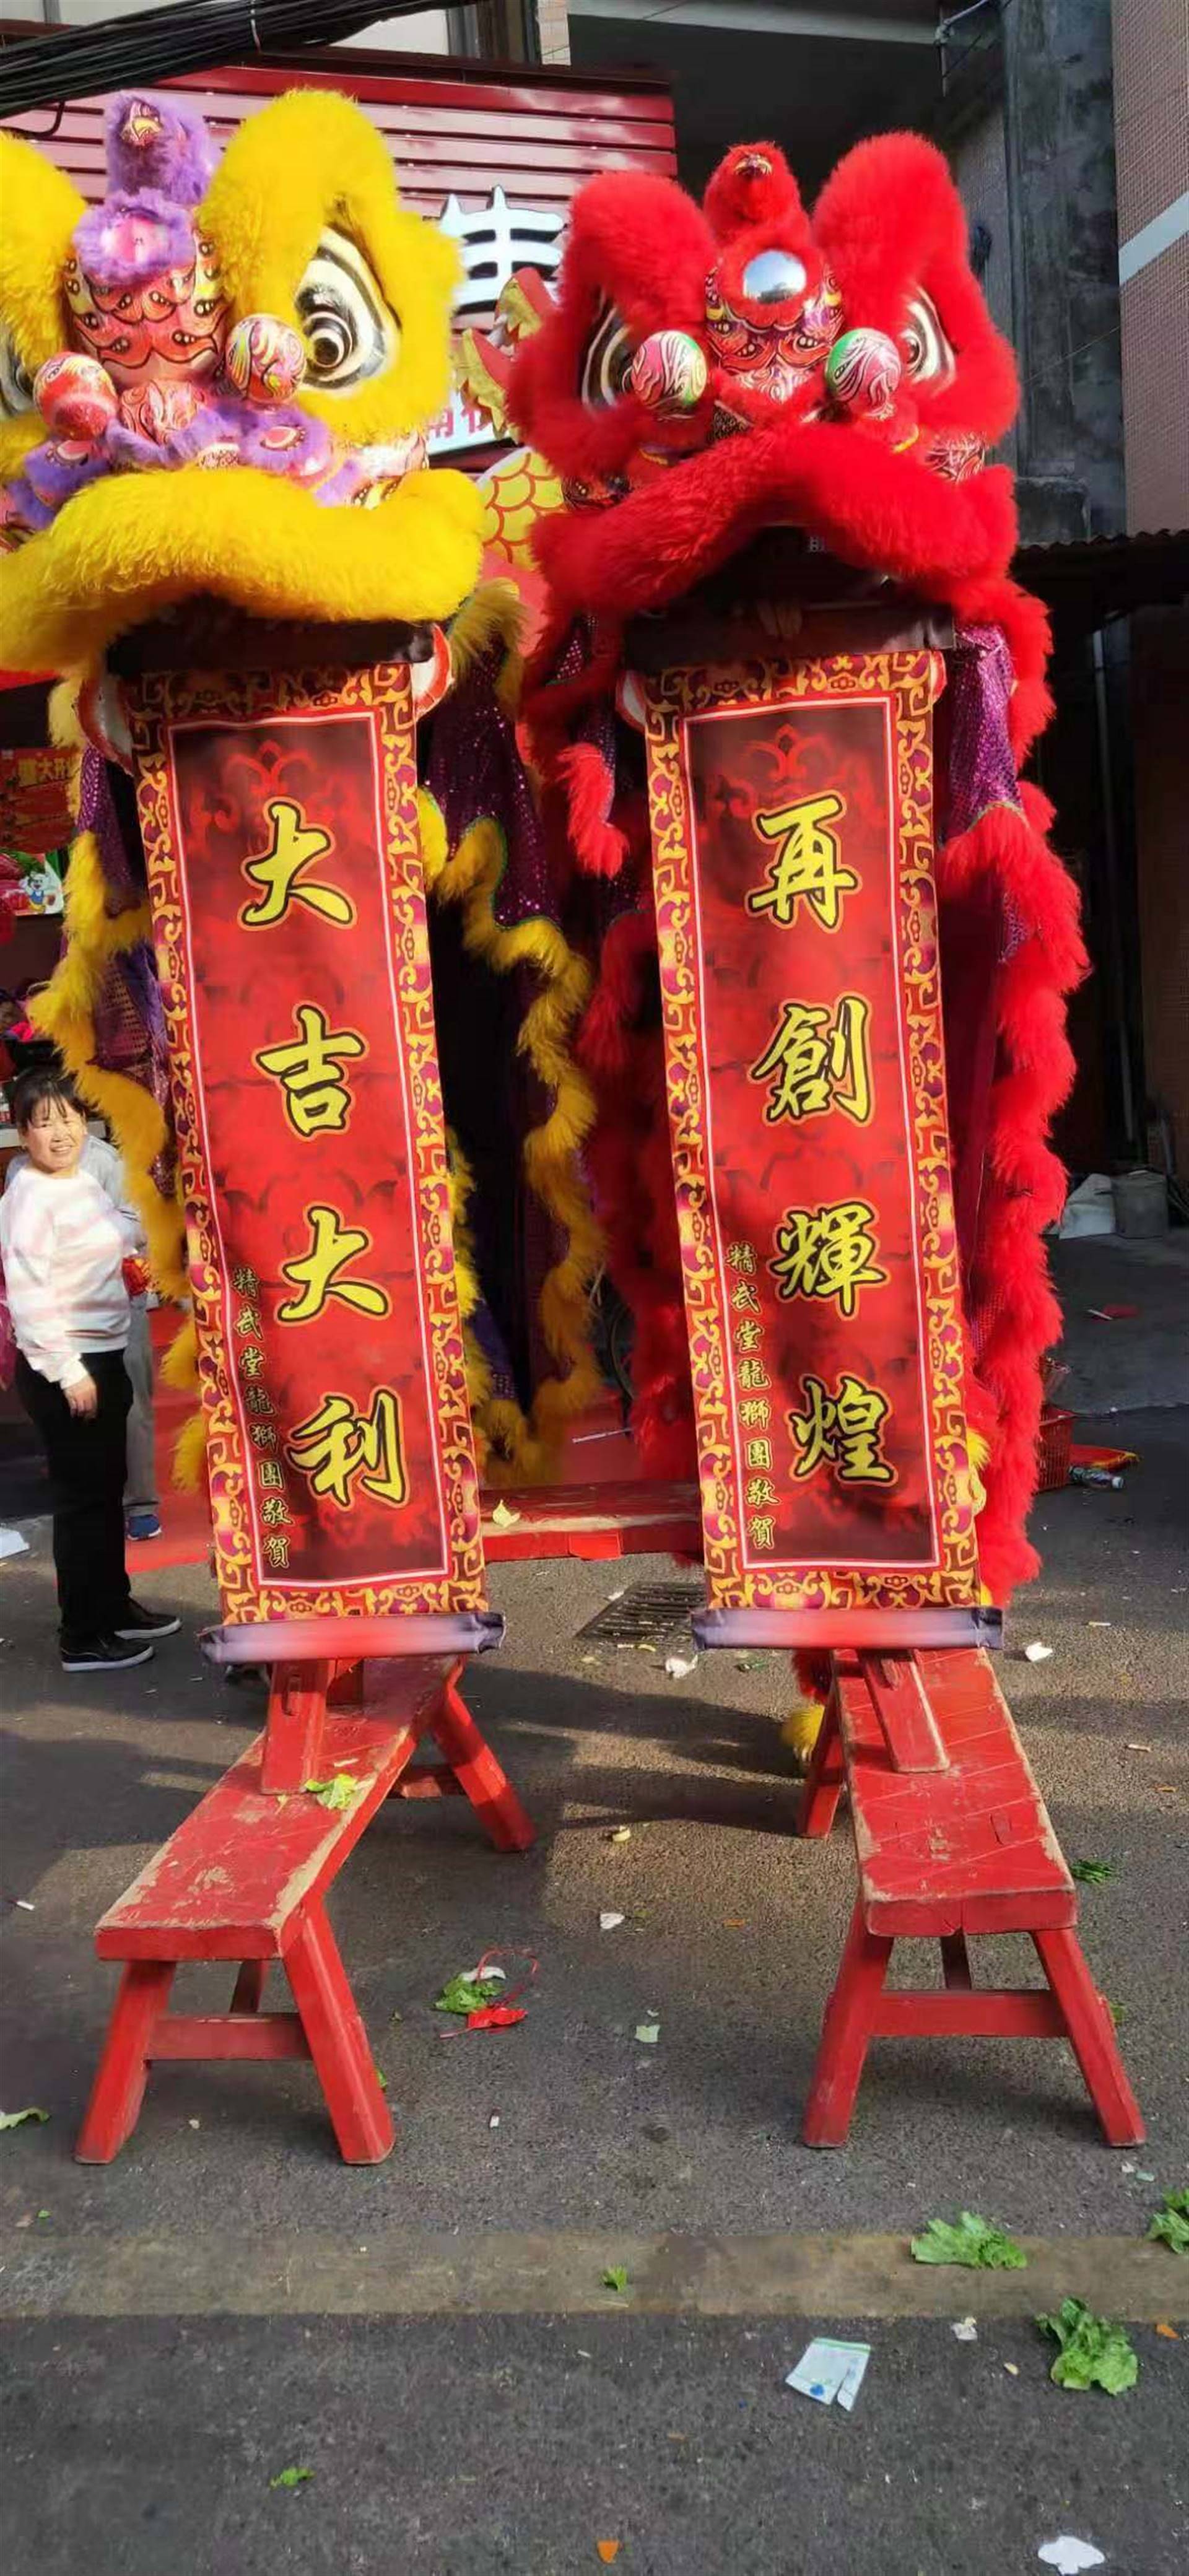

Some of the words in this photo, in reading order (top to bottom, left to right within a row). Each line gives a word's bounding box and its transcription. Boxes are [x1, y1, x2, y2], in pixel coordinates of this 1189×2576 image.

[242, 801, 406, 1507] 大吉大利
[747, 794, 895, 1483] 再創輝煌
